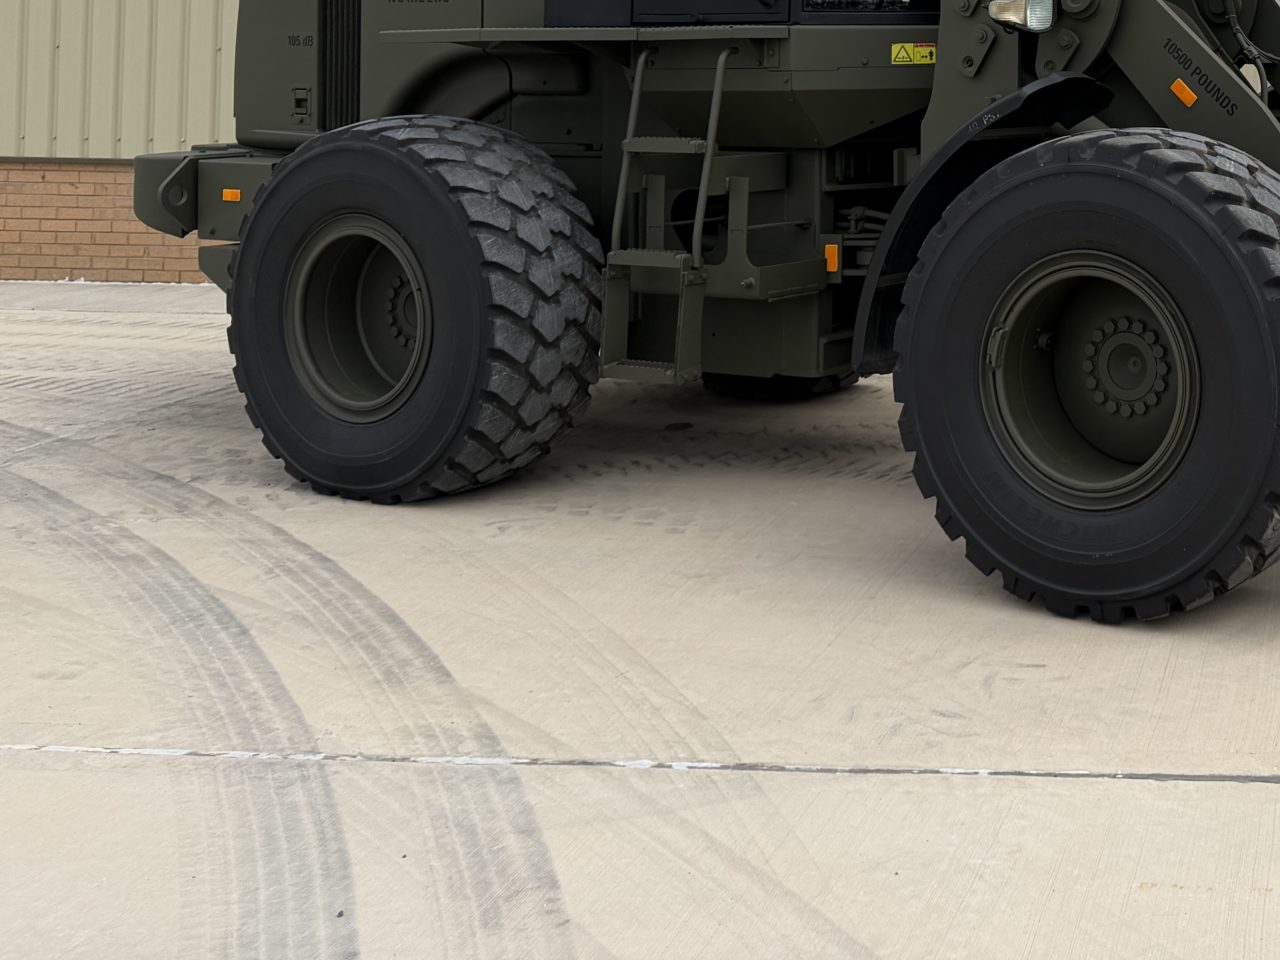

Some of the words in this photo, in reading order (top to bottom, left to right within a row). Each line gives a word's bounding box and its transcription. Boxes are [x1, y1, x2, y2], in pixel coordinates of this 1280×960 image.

[288, 35, 301, 46] 105
[303, 35, 314, 46] dB
[1163, 38, 1193, 71] 10500
[1190, 66, 1239, 116] POUNDS
